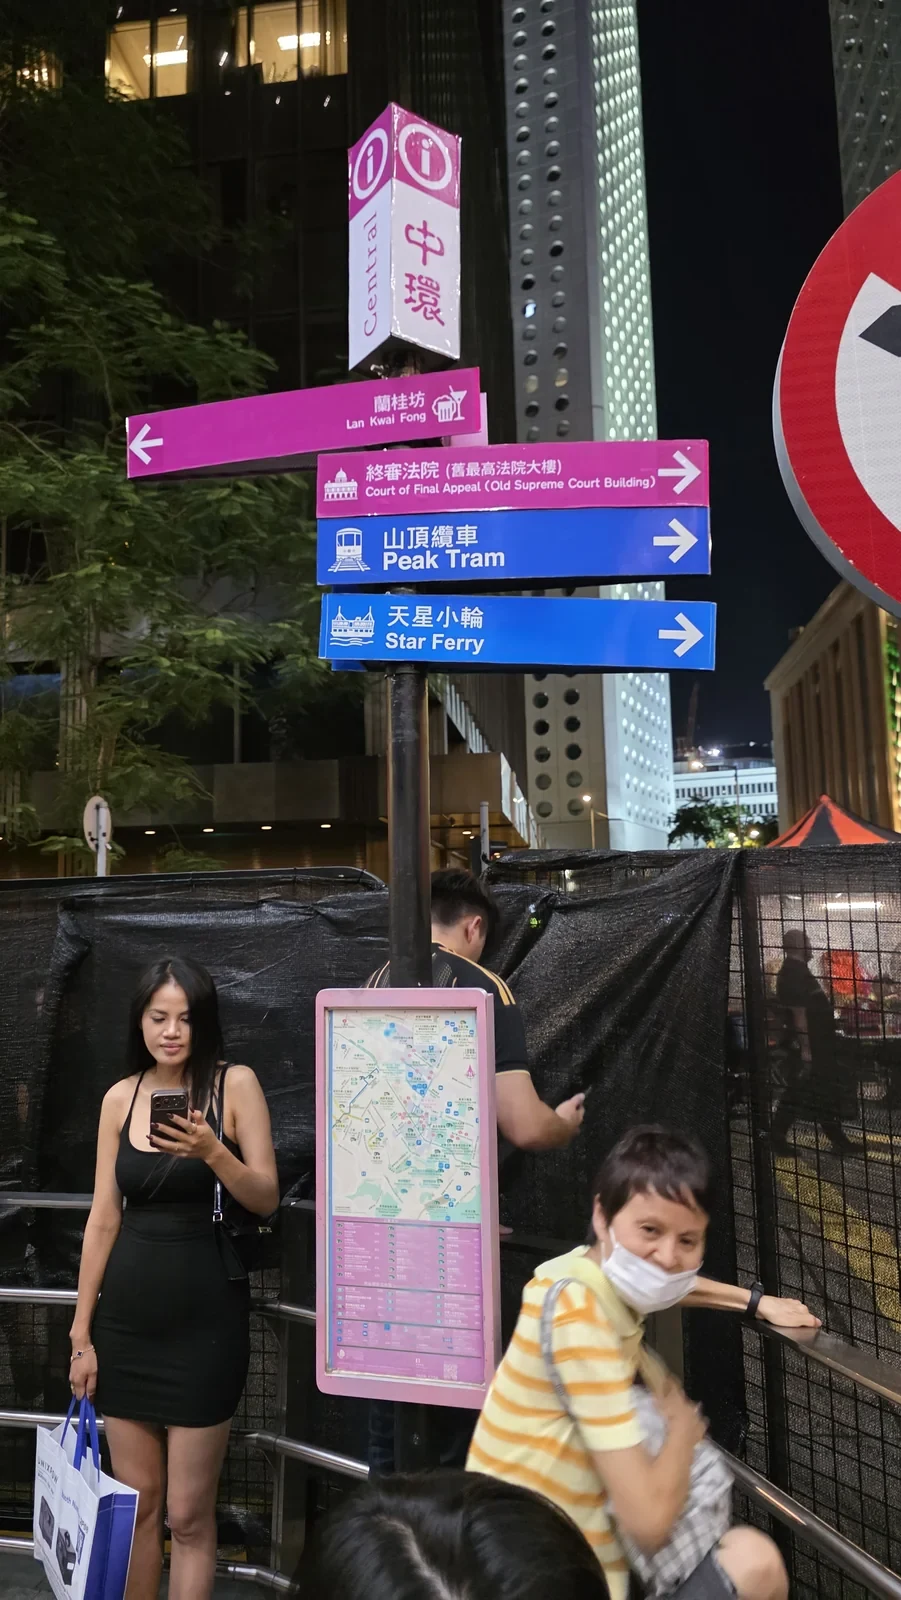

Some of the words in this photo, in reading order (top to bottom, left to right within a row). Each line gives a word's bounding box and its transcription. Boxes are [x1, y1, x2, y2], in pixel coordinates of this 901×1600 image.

[363, 210, 378, 337] Central
[404, 220, 445, 327] 中環
[373, 391, 425, 413] 蘭桂坊
[346, 418, 365, 429] Lan
[370, 414, 395, 426] Kwai
[400, 412, 427, 424] Fong
[365, 461, 439, 482] 終審法院
[446, 459, 562, 479] (舊最高法院大樓)
[365, 484, 396, 497] Court
[398, 483, 410, 495] of
[414, 482, 440, 494] Final
[442, 481, 481, 496] Appeal
[484, 479, 512, 493] (Old
[514, 478, 565, 491] Supreme
[568, 477, 601, 489] Court
[604, 475, 656, 489] Building)
[383, 524, 478, 549] 山頂纜車
[383, 550, 439, 571] Peak
[445, 549, 505, 568] Tram
[387, 605, 484, 629] 天星小輪
[385, 632, 426, 650] Star
[432, 633, 485, 655] Ferry
